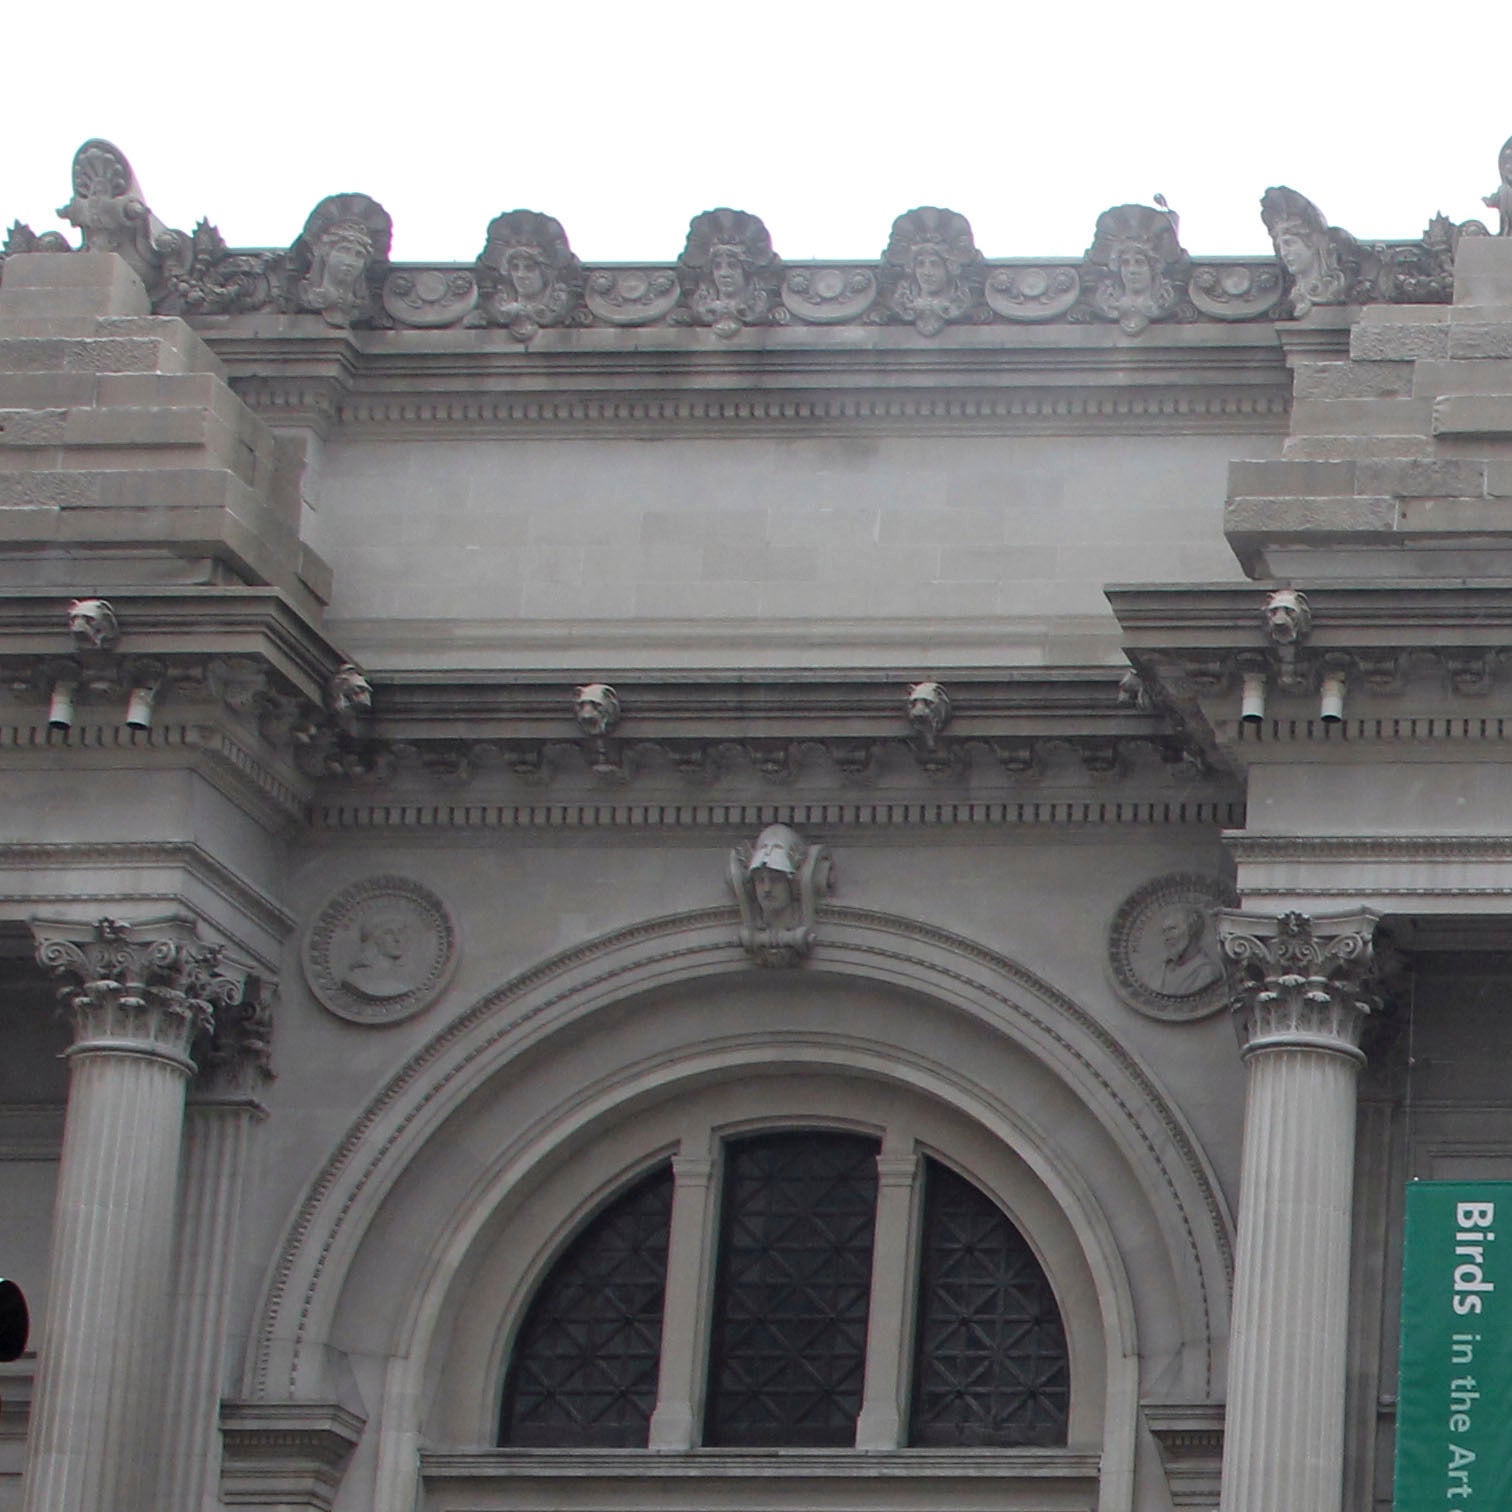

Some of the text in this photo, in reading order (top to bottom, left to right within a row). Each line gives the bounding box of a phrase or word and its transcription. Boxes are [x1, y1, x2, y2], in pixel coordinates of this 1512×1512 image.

[1452, 1202, 1495, 1316] Birds
[1450, 1333, 1482, 1365] in
[1448, 1375, 1481, 1434] the
[1446, 1443, 1477, 1498] Art
